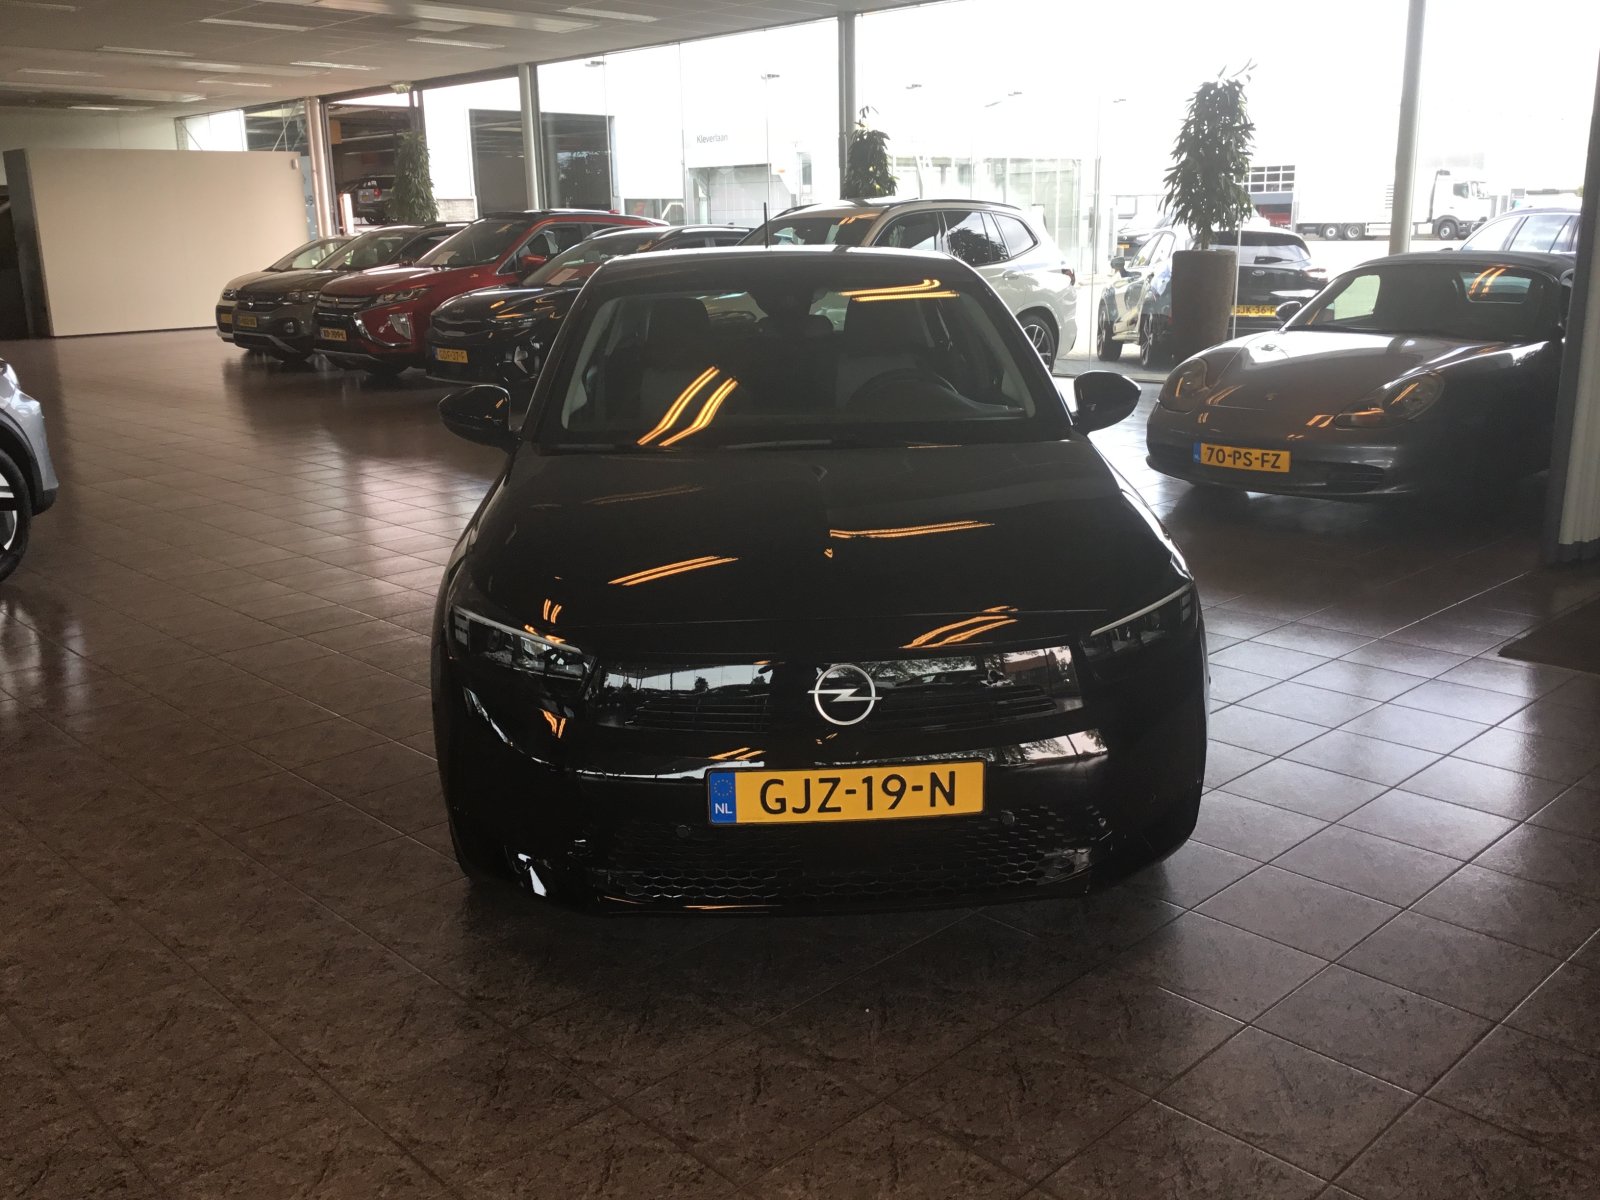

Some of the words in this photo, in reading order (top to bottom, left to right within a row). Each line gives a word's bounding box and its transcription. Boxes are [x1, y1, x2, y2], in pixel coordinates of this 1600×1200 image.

[1206, 447, 1282, 469] 70-PS-FZ
[715, 803, 733, 815] NL
[760, 771, 956, 815] GJZ-19-N
